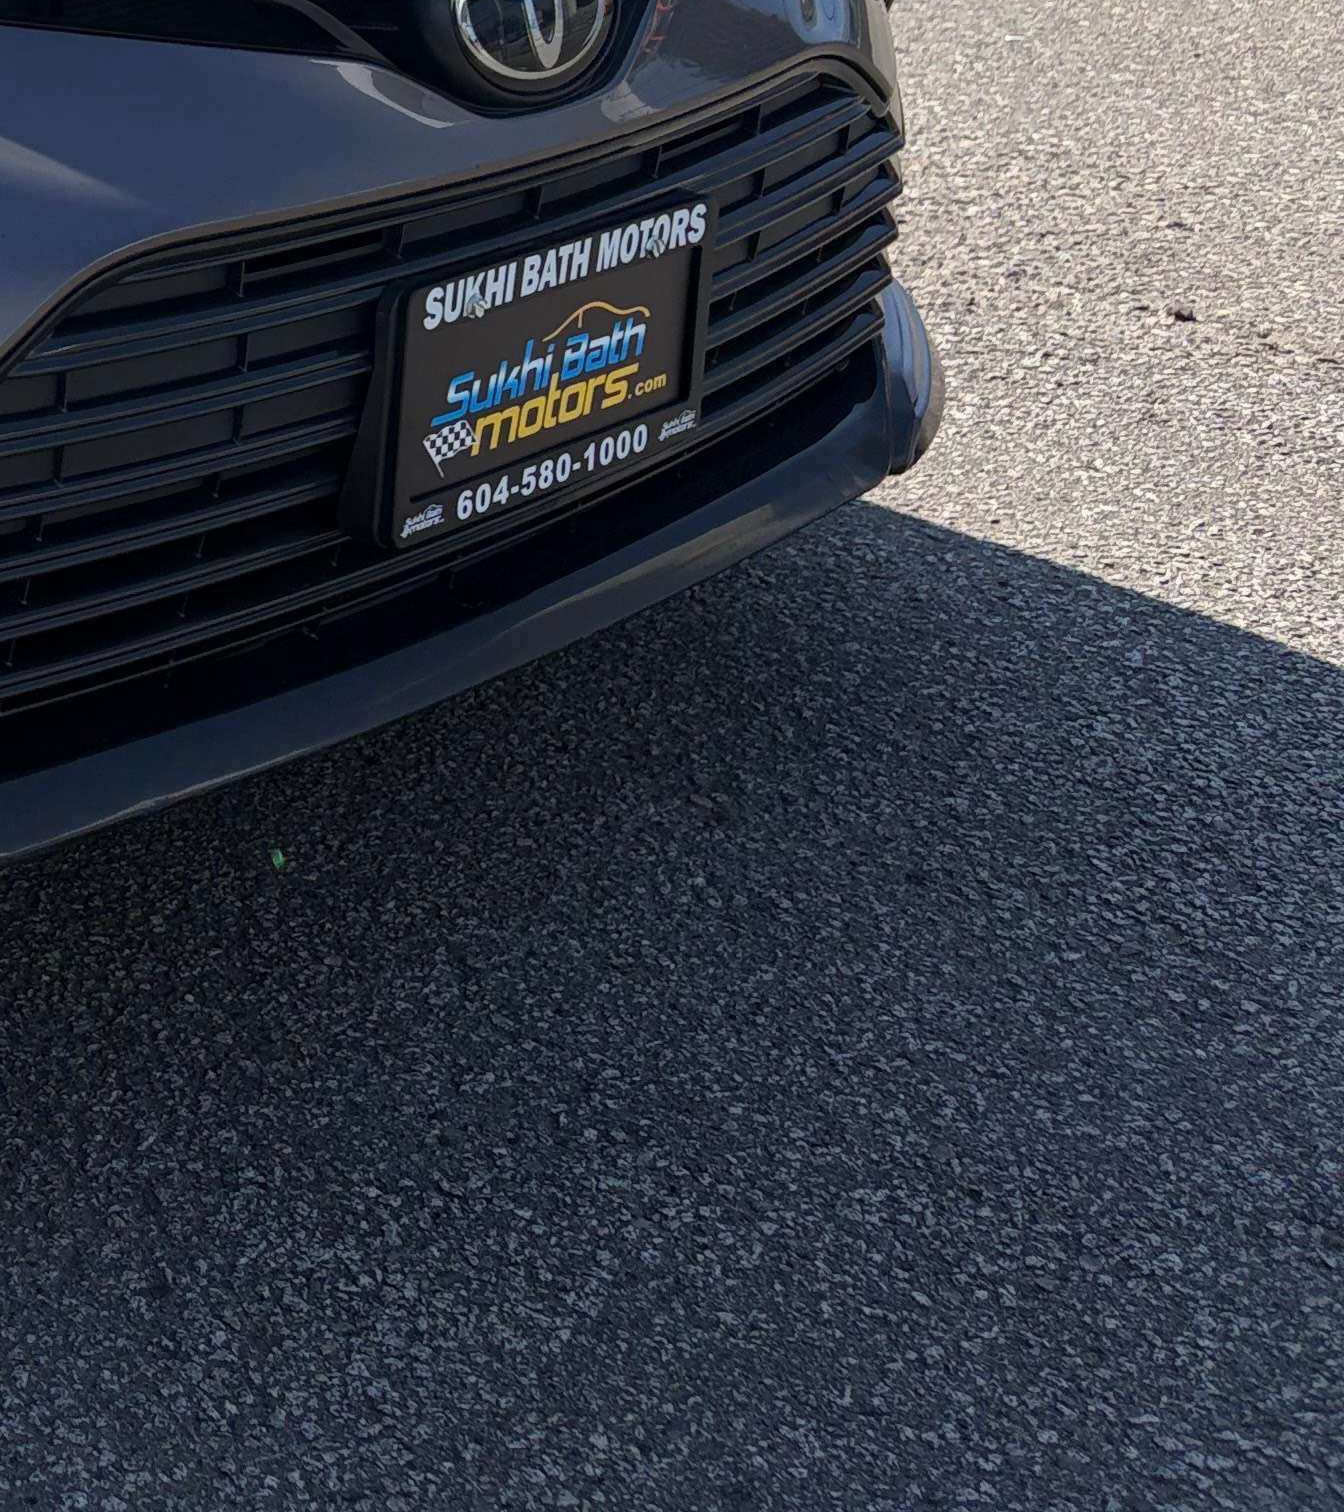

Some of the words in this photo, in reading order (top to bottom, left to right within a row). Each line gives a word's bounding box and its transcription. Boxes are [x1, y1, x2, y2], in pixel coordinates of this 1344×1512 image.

[423, 257, 517, 330] SUKHI
[520, 237, 593, 297] BATH
[596, 203, 708, 273] MOTORS
[431, 336, 556, 428] Sukhi
[560, 317, 648, 379] Bath
[456, 423, 649, 521] 604-580-1000
